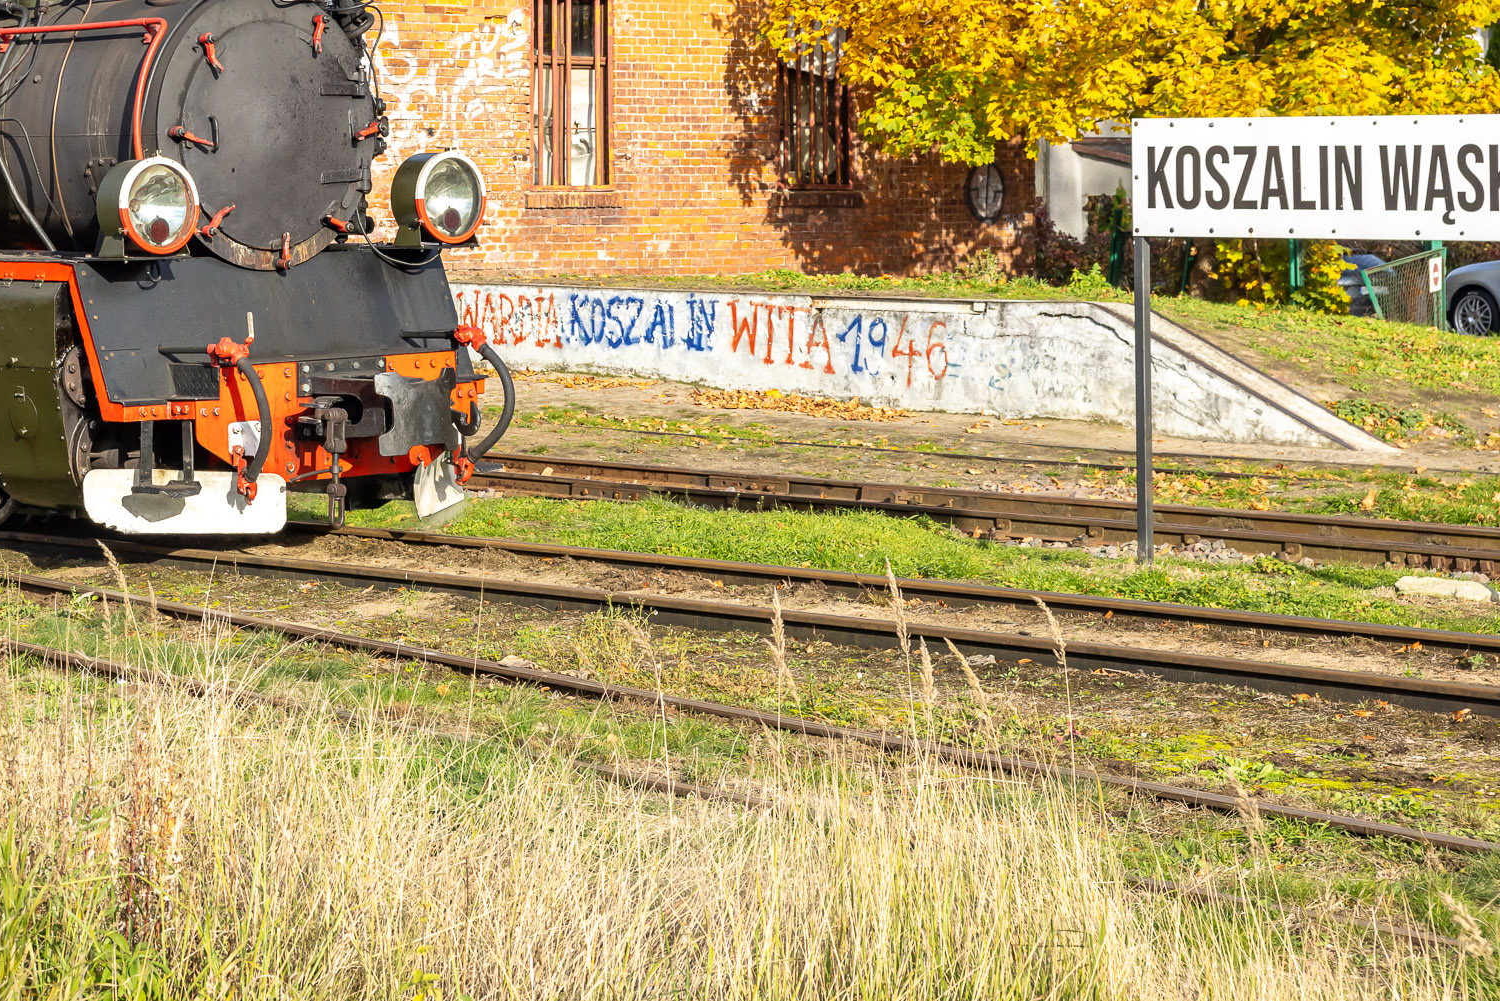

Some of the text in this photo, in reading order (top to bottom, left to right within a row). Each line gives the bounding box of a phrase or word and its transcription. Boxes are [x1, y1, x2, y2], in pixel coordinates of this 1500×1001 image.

[1147, 144, 1363, 211] KOSZALIN
[567, 292, 719, 352] KOSZALIN
[726, 297, 836, 374] WITA
[835, 313, 949, 388] 1946
